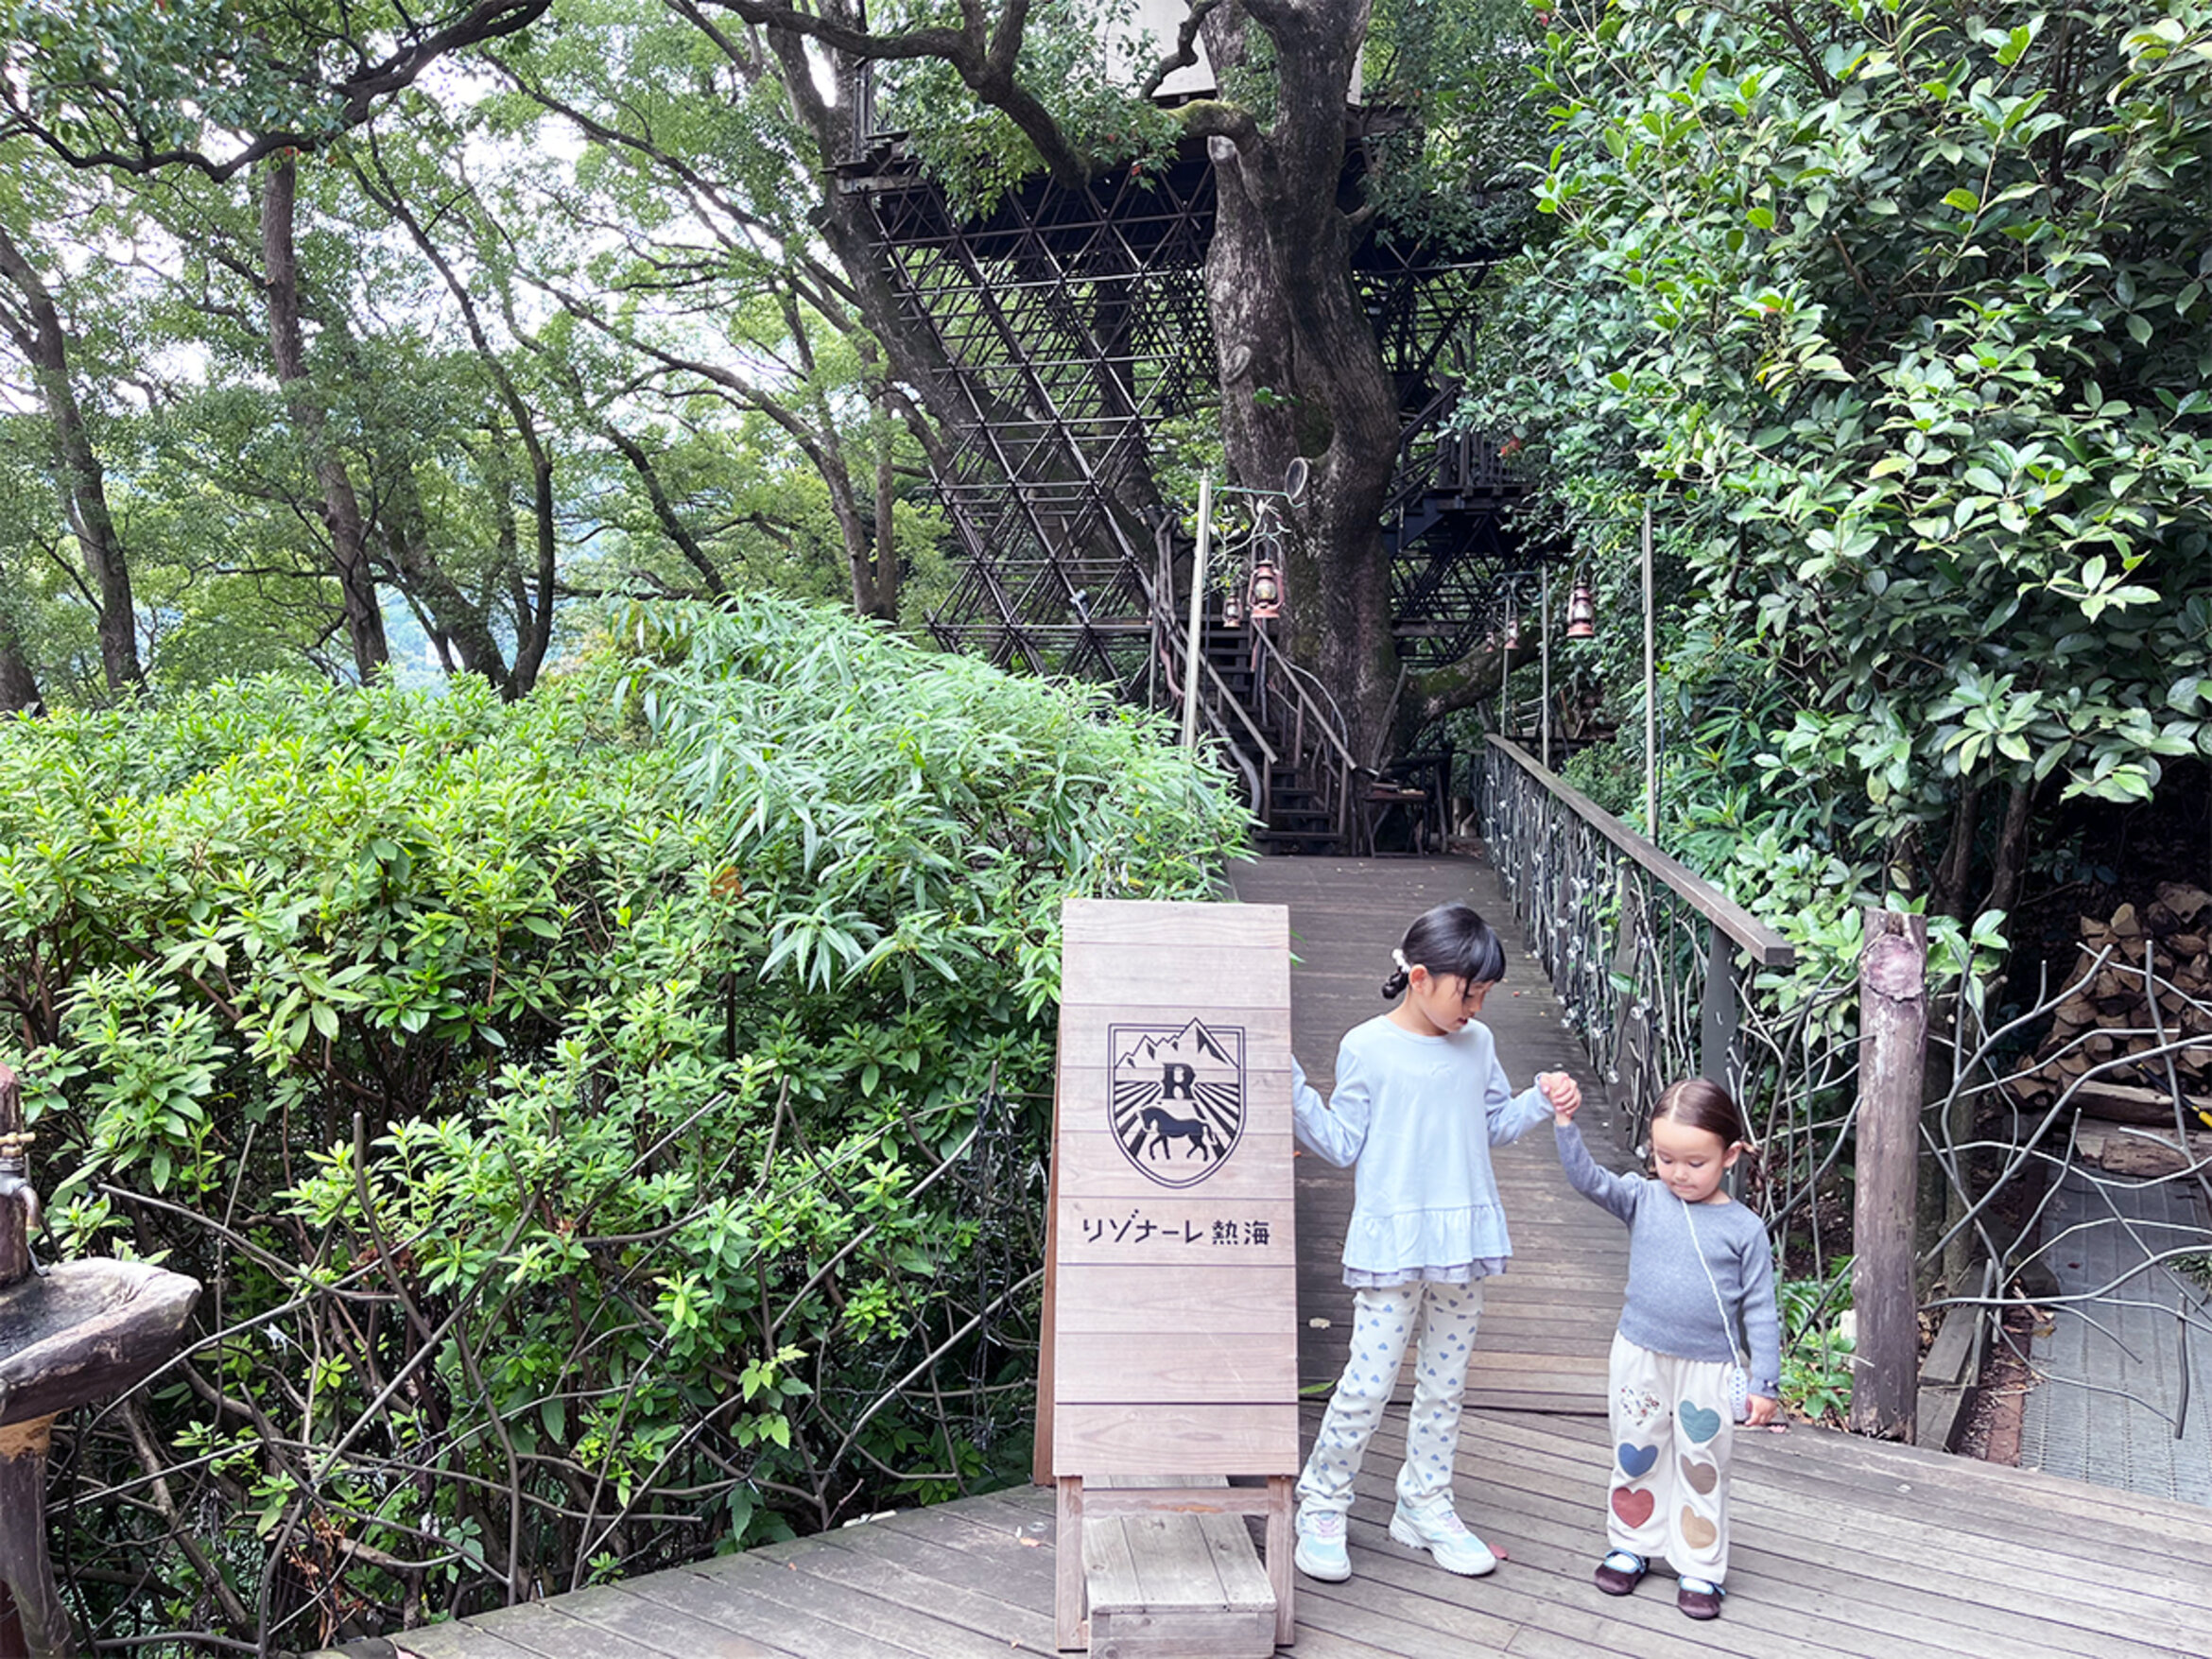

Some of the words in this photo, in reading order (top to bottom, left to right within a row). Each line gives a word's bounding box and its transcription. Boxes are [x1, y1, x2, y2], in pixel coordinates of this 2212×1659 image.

[1162, 1063, 1196, 1099] R
[1083, 1209, 1270, 1245] リゾナーレ熱海
